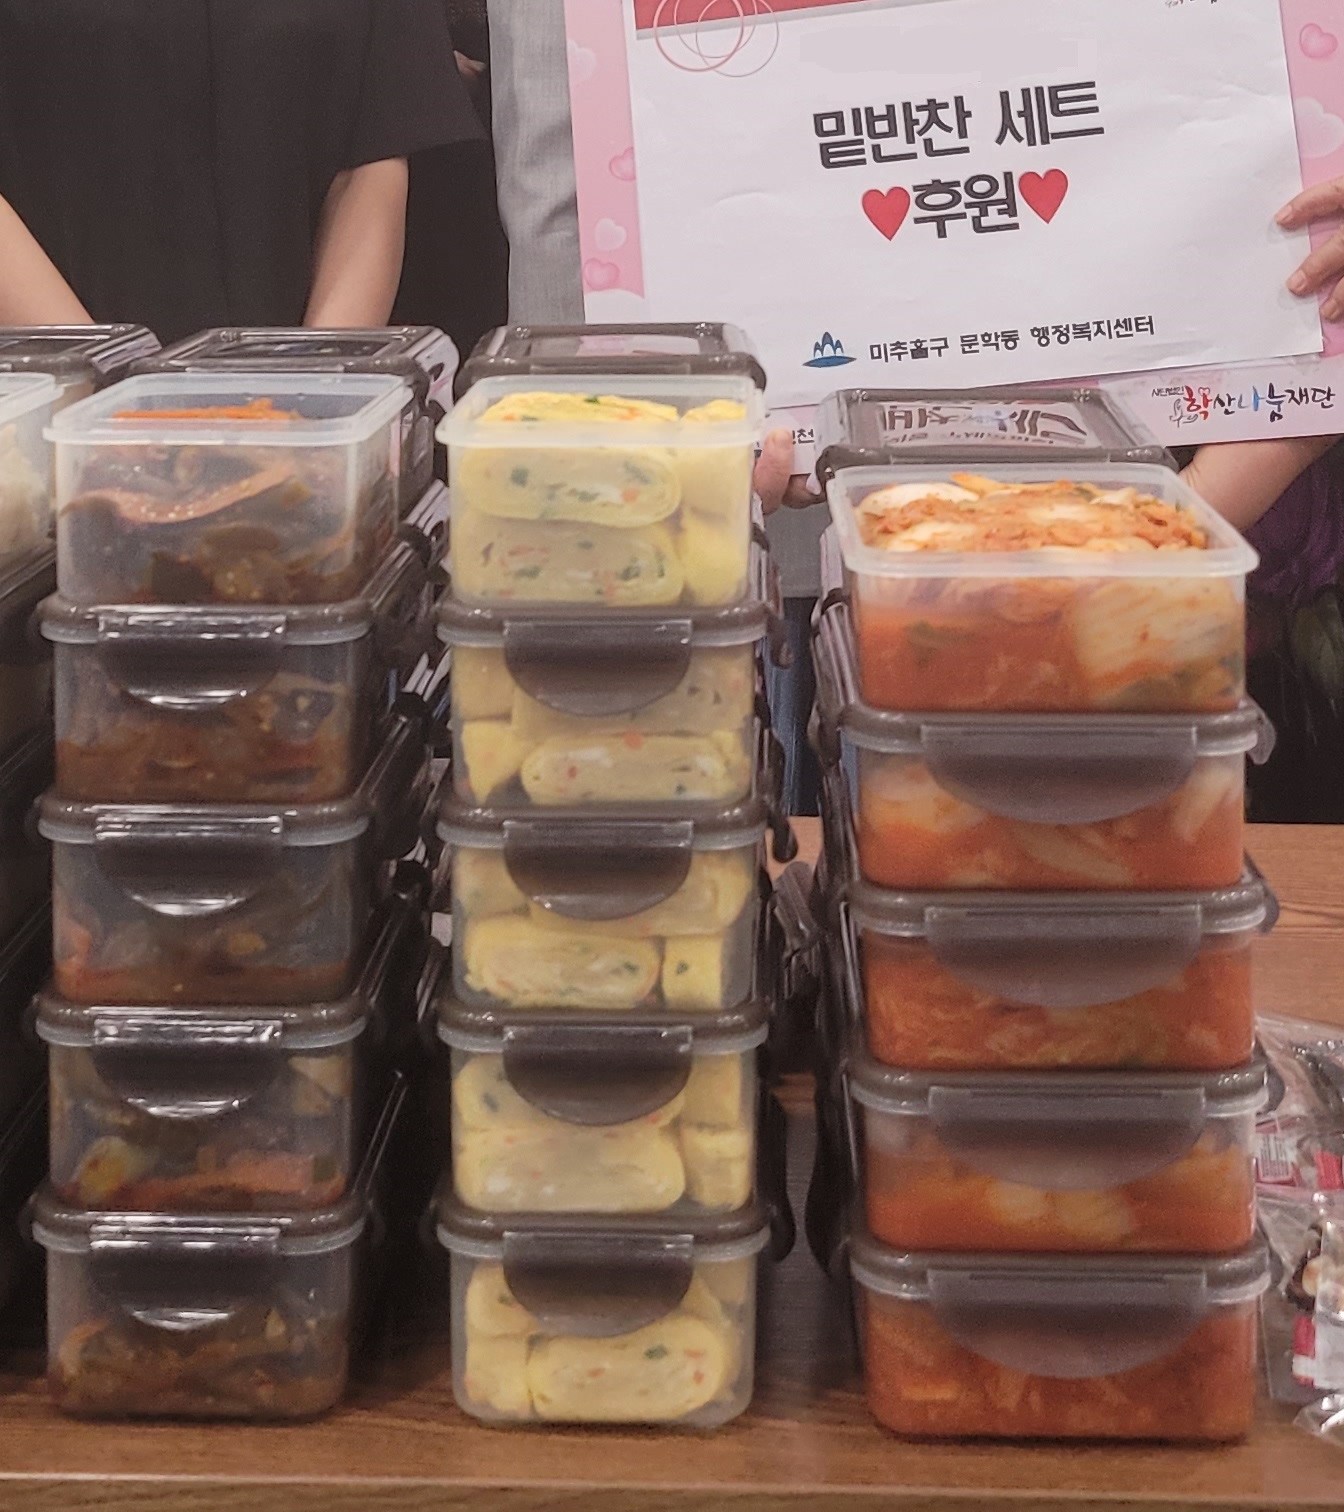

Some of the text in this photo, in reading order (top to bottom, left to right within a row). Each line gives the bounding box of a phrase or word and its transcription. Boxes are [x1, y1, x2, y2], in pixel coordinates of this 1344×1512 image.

[813, 81, 1105, 169] 밑반찬 세트
[912, 171, 1020, 239] 후원
[869, 315, 1155, 363] 미추홀구 문학동 행정복지센터
[1183, 382, 1336, 423] 학산나눔재단
